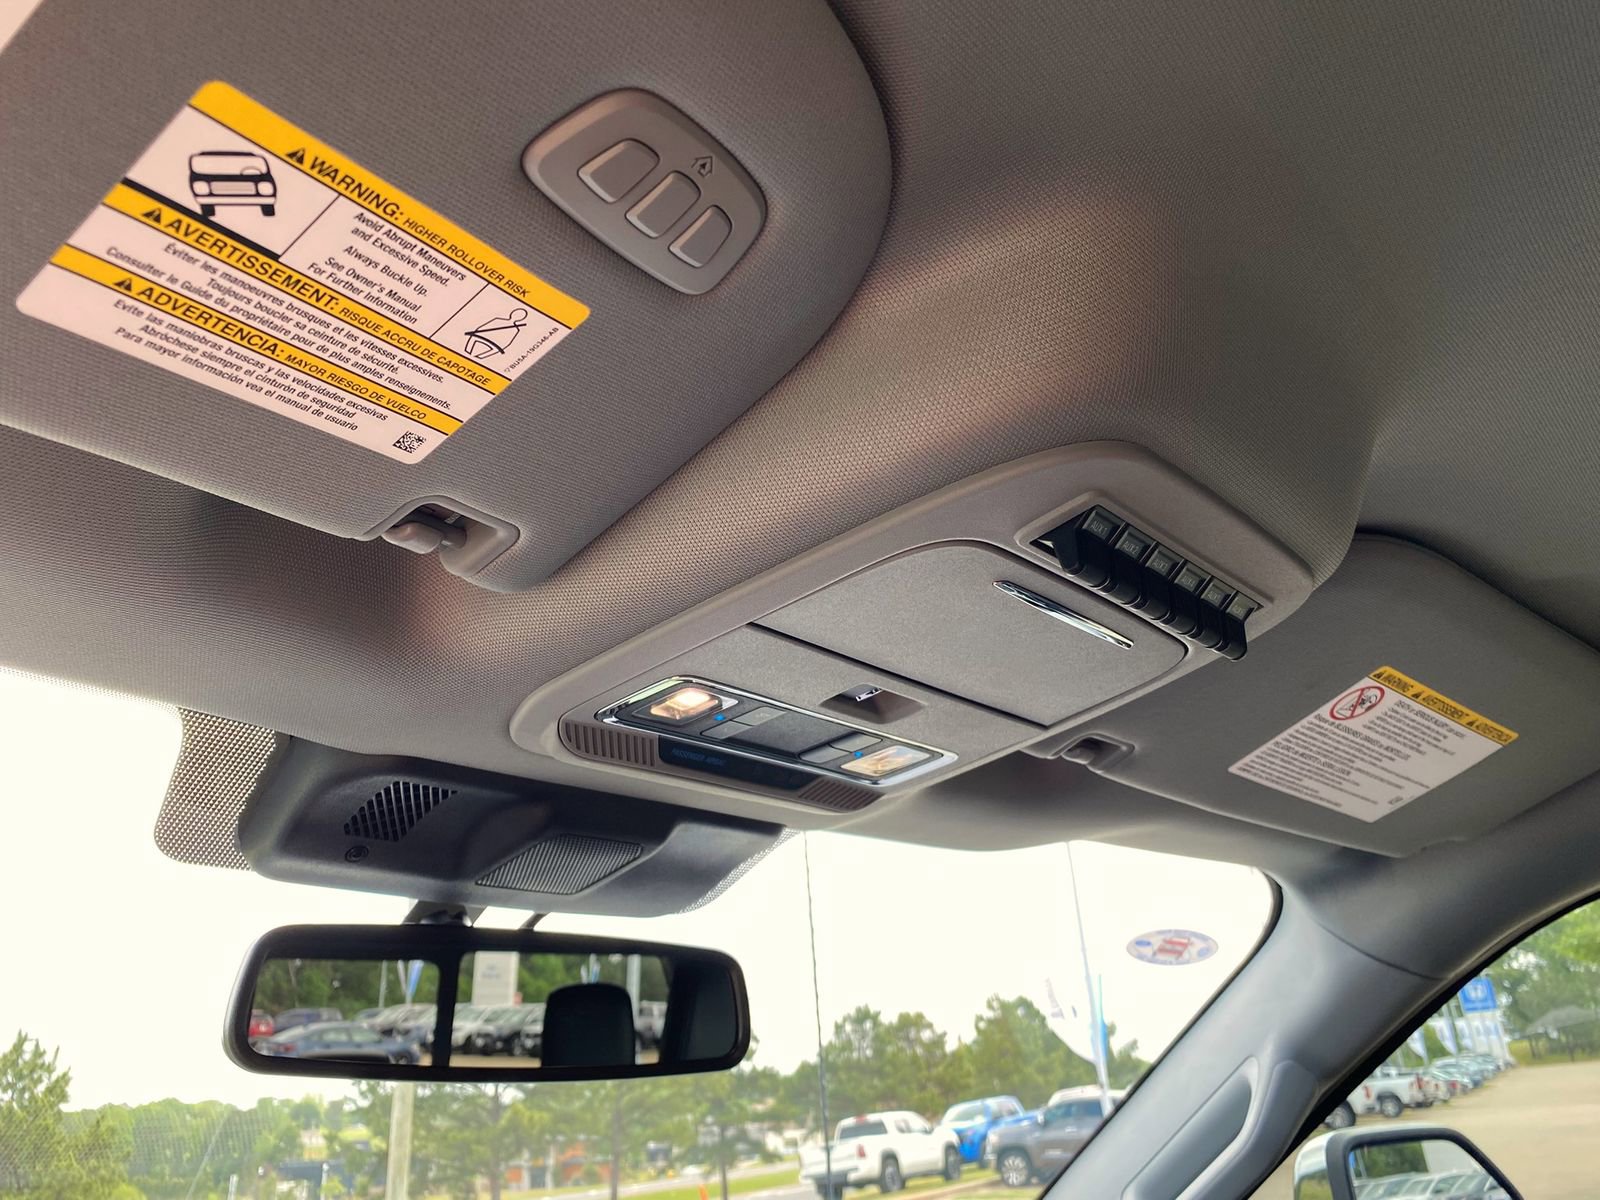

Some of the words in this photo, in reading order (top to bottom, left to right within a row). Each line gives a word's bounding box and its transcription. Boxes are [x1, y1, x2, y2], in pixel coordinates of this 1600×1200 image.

[309, 156, 404, 221] WARNING:
[402, 216, 447, 249] HIGHER
[447, 244, 505, 284] ROLLOVER
[504, 279, 531, 299] RISK
[343, 245, 381, 270] Always
[379, 264, 414, 288] Buckle
[412, 282, 428, 297] Up.
[351, 227, 374, 242] and
[371, 236, 420, 269] Excessive
[418, 263, 451, 287] Speed.
[353, 212, 385, 233] Avoid
[381, 228, 418, 253] Abrupt
[415, 247, 467, 281] Maneuvers
[106, 246, 166, 278] Consulter
[166, 273, 179, 285] le
[180, 280, 214, 301] Guide
[213, 297, 231, 309] du
[228, 304, 292, 337] propriétaire
[289, 333, 317, 348] pour
[315, 344, 330, 355] de
[327, 350, 352, 365] plus
[350, 360, 385, 380] amples
[383, 375, 451, 411] renseignements.
[163, 242, 201, 265] Éviter
[200, 260, 219, 275] les
[218, 271, 286, 307] manoeuvres
[284, 301, 333, 330] brusques
[331, 326, 345, 336] et
[343, 330, 360, 343] les
[359, 338, 398, 361] vitesses
[396, 357, 444, 384] excessives.
[164, 218, 340, 311] AVERTISSEMENT:
[338, 306, 384, 334] RISQUE
[380, 329, 423, 352] ACCRU
[419, 347, 439, 361] DE
[436, 355, 492, 386] CAPOTAGE
[207, 277, 254, 306] Toujours
[253, 300, 294, 324] boucler
[292, 321, 308, 331] sa
[307, 327, 348, 350] ceinture
[347, 346, 362, 357] de
[360, 352, 400, 375] sécurité.
[307, 262, 327, 277] For
[325, 271, 365, 296] Further
[363, 291, 418, 325] Information
[324, 256, 346, 273] See
[345, 267, 386, 294] Owner's
[384, 288, 423, 313] Manual
[113, 299, 145, 317] Evite
[145, 312, 165, 326] las
[165, 322, 224, 352] maniobras
[224, 346, 267, 370] bruscas
[264, 365, 275, 374] y
[274, 368, 291, 381] las
[291, 376, 347, 404] velocidades
[345, 399, 389, 422] excesivas
[114, 326, 143, 344] Para
[144, 340, 182, 359] mayor
[181, 353, 245, 385] información
[245, 381, 264, 393] vea
[263, 389, 277, 398] el
[274, 393, 313, 413] manual
[310, 408, 325, 418] de
[323, 413, 359, 431] usuario
[136, 286, 285, 358] ADVERTENCIA:
[284, 353, 327, 377] MAYOR
[325, 372, 369, 395] RIESGO
[368, 390, 387, 403] DE
[385, 397, 427, 420] VUELCO
[139, 324, 200, 354] Abróchese
[199, 350, 244, 373] siempre
[243, 368, 257, 378] el
[254, 373, 297, 395] cinturón
[296, 390, 311, 401] de
[309, 396, 358, 419] seguridad
[1089, 519, 1108, 536] AUX1
[1122, 540, 1139, 555] AUX2
